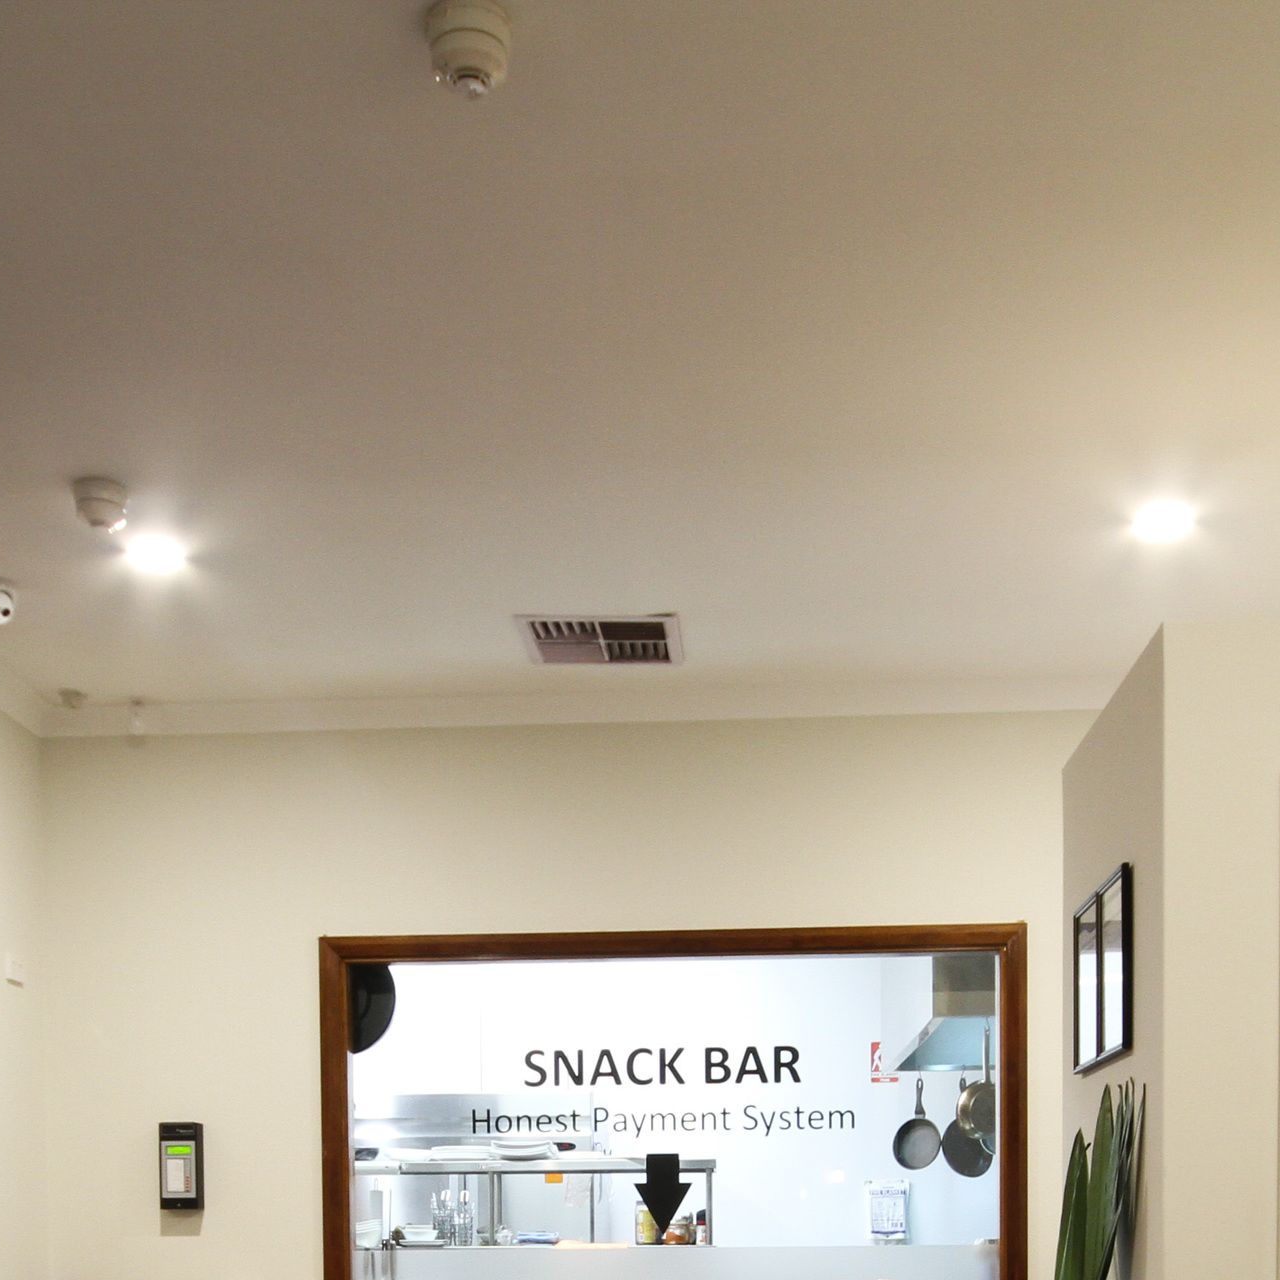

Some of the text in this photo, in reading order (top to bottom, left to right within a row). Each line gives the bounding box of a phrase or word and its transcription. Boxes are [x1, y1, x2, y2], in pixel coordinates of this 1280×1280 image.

[523, 1045, 802, 1087] SNACK BAR
[471, 1104, 856, 1139] Honest Payment System
